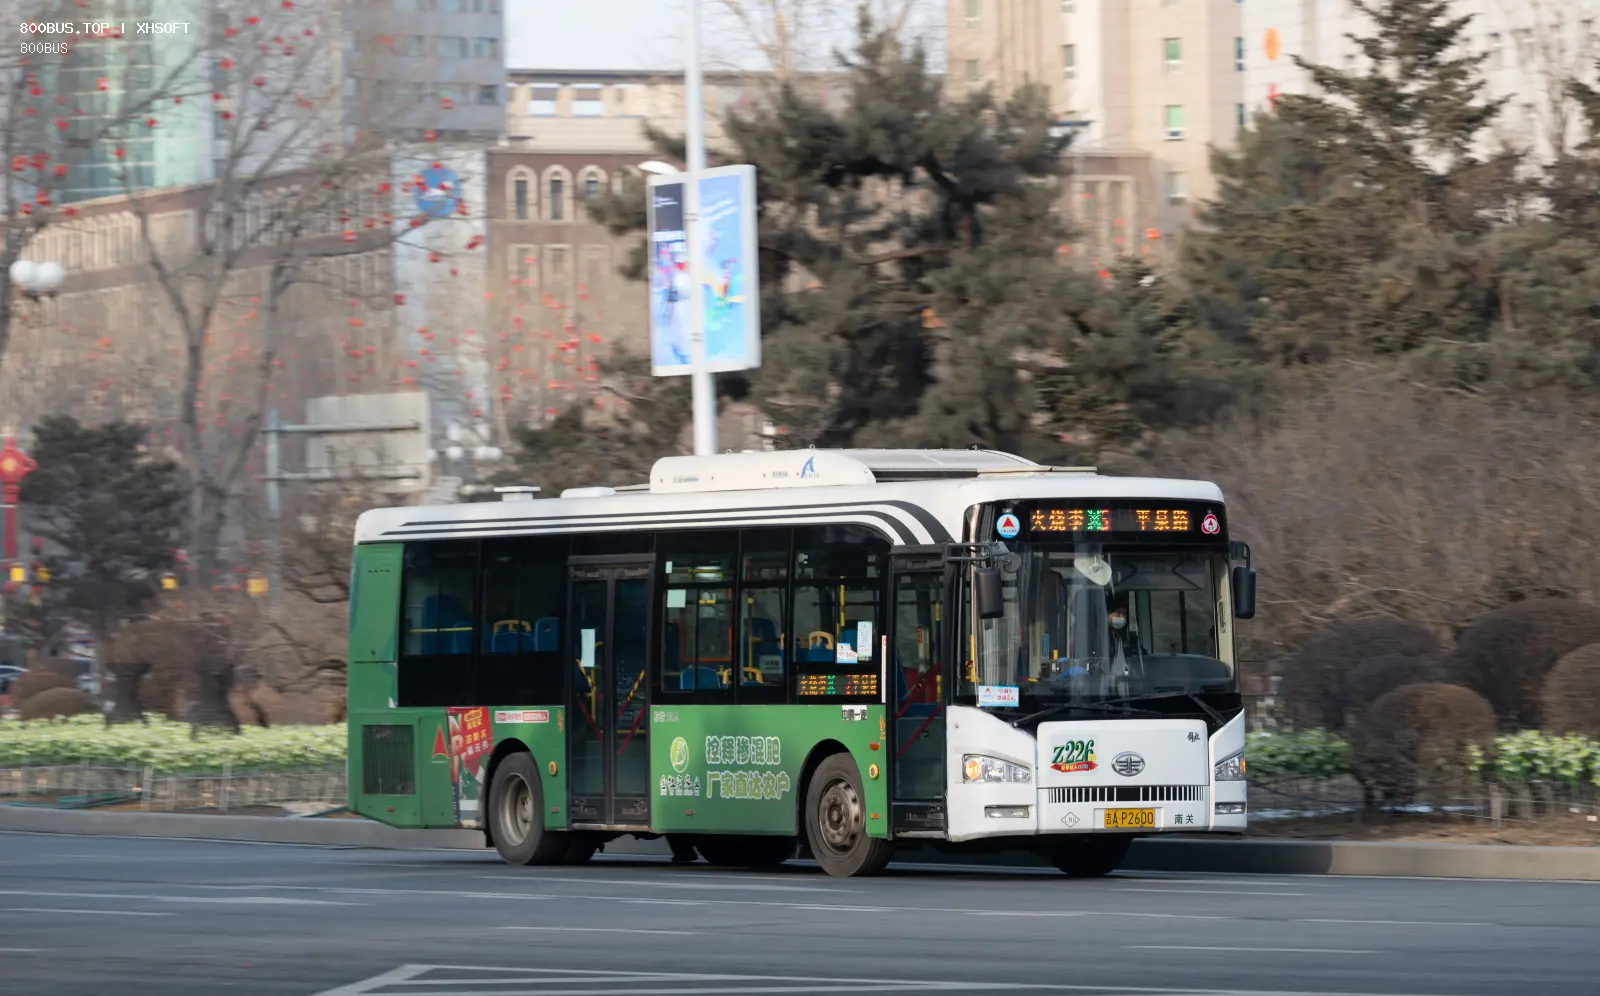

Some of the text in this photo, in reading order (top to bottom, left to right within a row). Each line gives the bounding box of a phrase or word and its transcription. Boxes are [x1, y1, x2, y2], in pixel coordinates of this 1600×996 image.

[1052, 739, 1095, 764] Z226
[706, 770, 791, 800] 厂家直达农户
[1174, 813, 1195, 825] 南关
